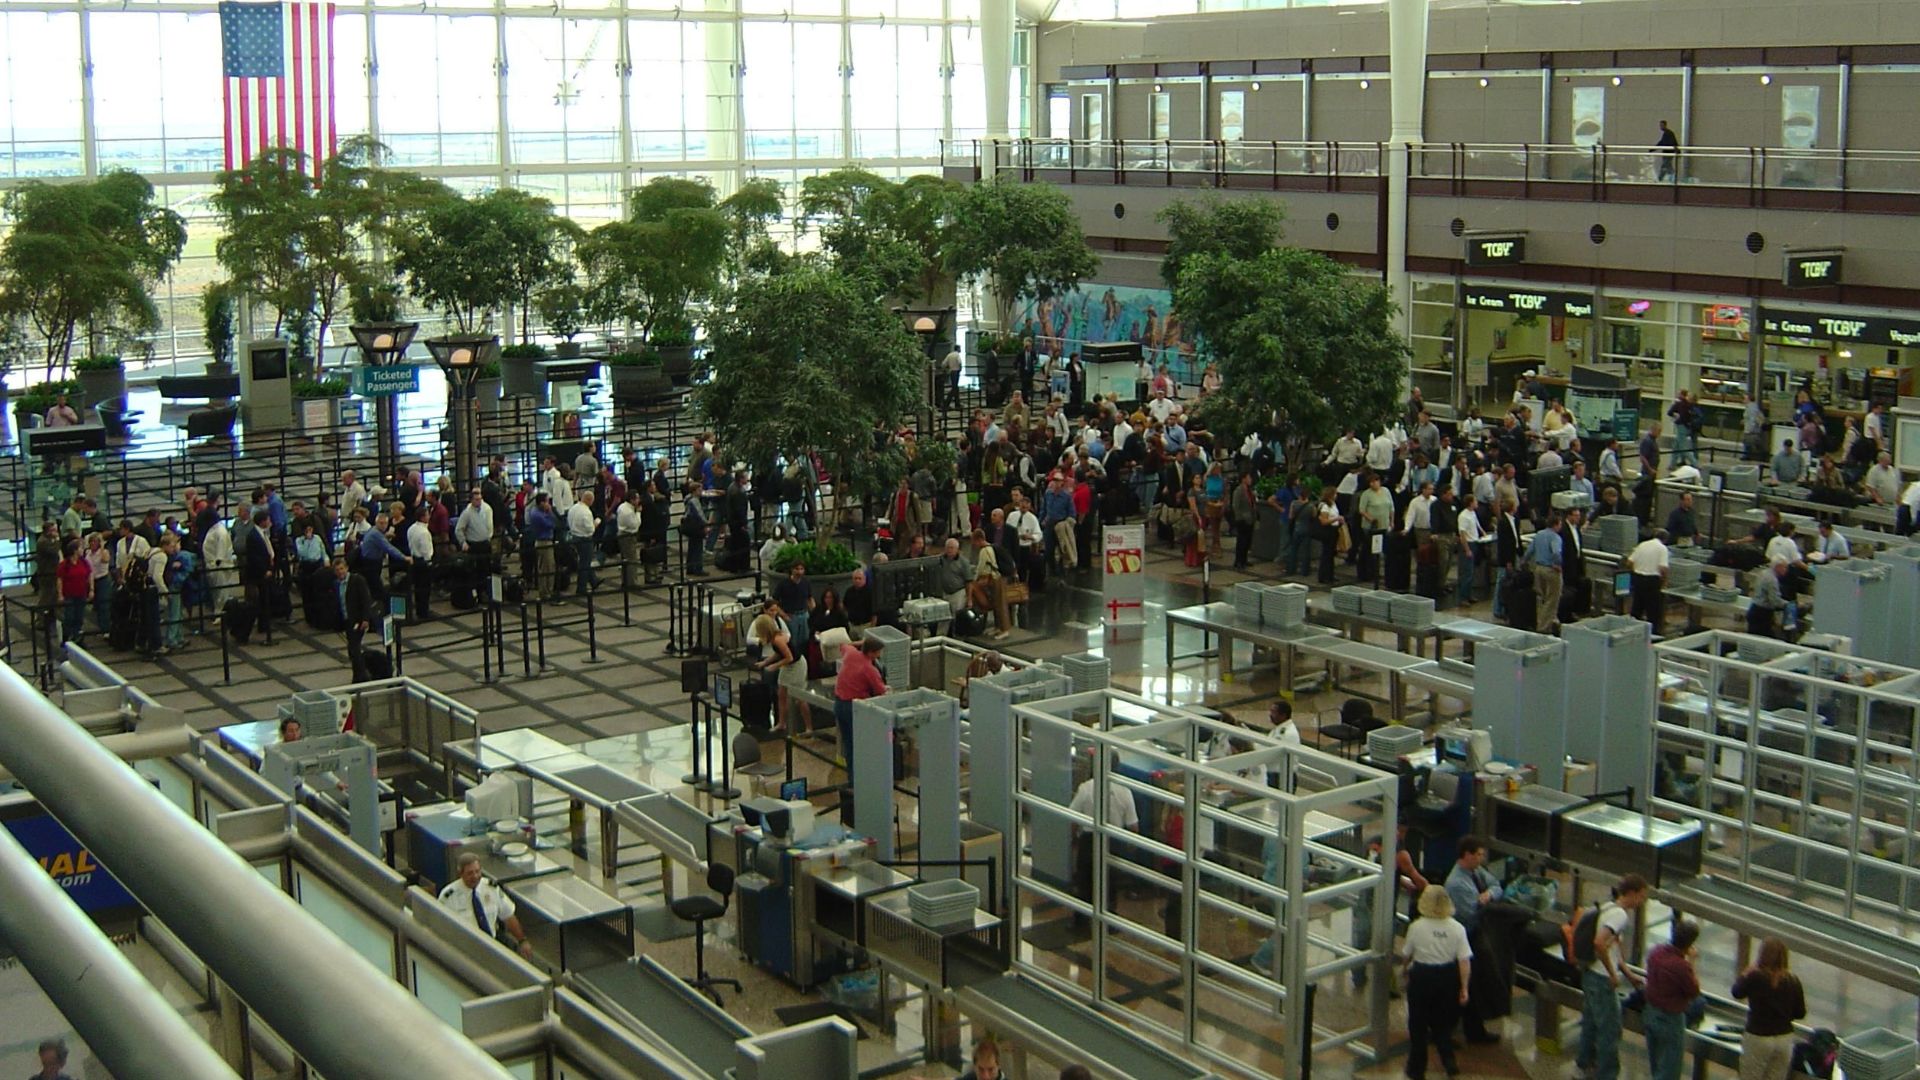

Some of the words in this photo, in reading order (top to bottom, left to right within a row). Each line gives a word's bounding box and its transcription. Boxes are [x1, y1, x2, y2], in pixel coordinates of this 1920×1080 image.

[1466, 295, 1477, 305] Ice
[1479, 295, 1504, 308] Cream
[1565, 302, 1592, 316] Yogurt
[1765, 320, 1778, 331] Ice
[1781, 320, 1812, 334] Cream
[372, 369, 412, 381] Ticketed
[367, 380, 417, 392] Passengers
[1107, 533, 1124, 546] Stop
